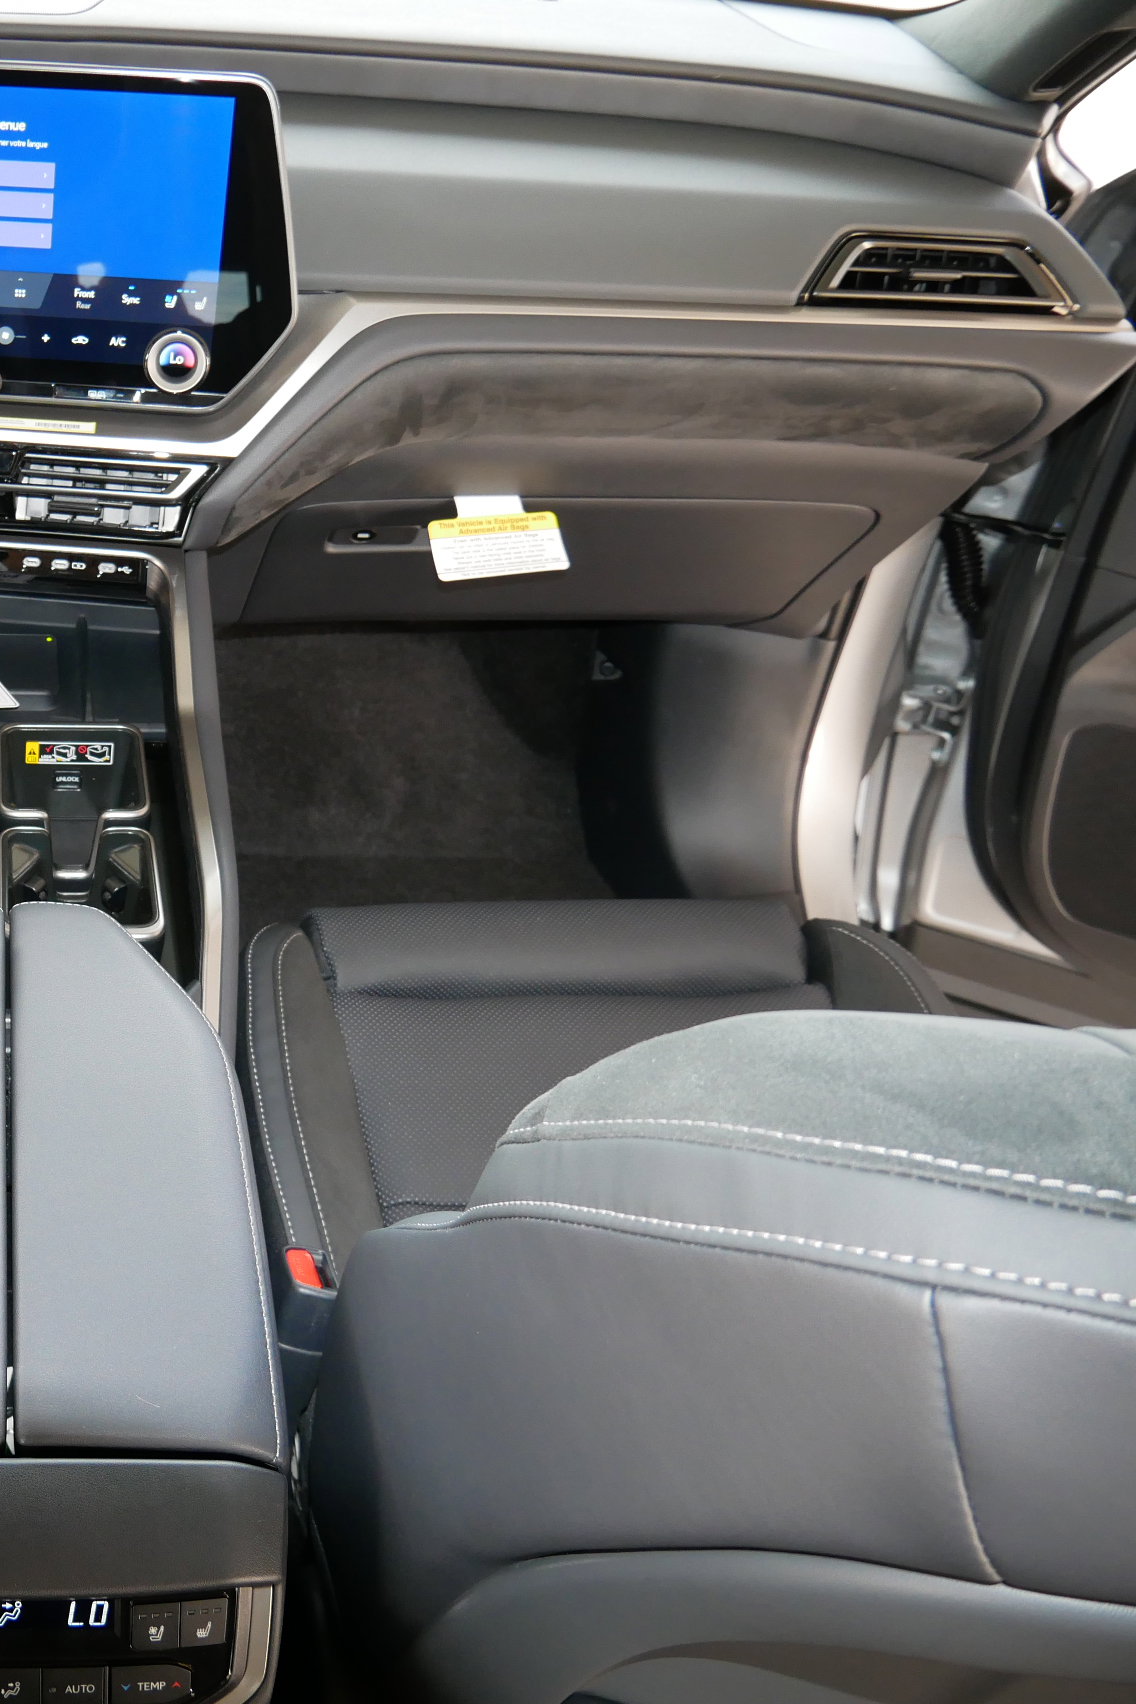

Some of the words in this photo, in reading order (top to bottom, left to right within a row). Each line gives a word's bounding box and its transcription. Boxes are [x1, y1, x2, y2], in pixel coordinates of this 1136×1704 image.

[10, 139, 26, 148] votre
[27, 139, 48, 150] langue
[73, 287, 96, 299] Front
[76, 301, 92, 310] Rear
[121, 294, 141, 306] Sync
[109, 336, 127, 347] A/C
[169, 352, 184, 365] Lo
[439, 521, 455, 530] This
[457, 519, 483, 529] Vehicle
[494, 516, 530, 526] Equipped
[531, 514, 548, 522] with
[459, 526, 496, 535] Advanced
[510, 523, 530, 532] Bags
[65, 1683, 95, 1694] AUTO
[137, 1681, 166, 1691] TEMP
